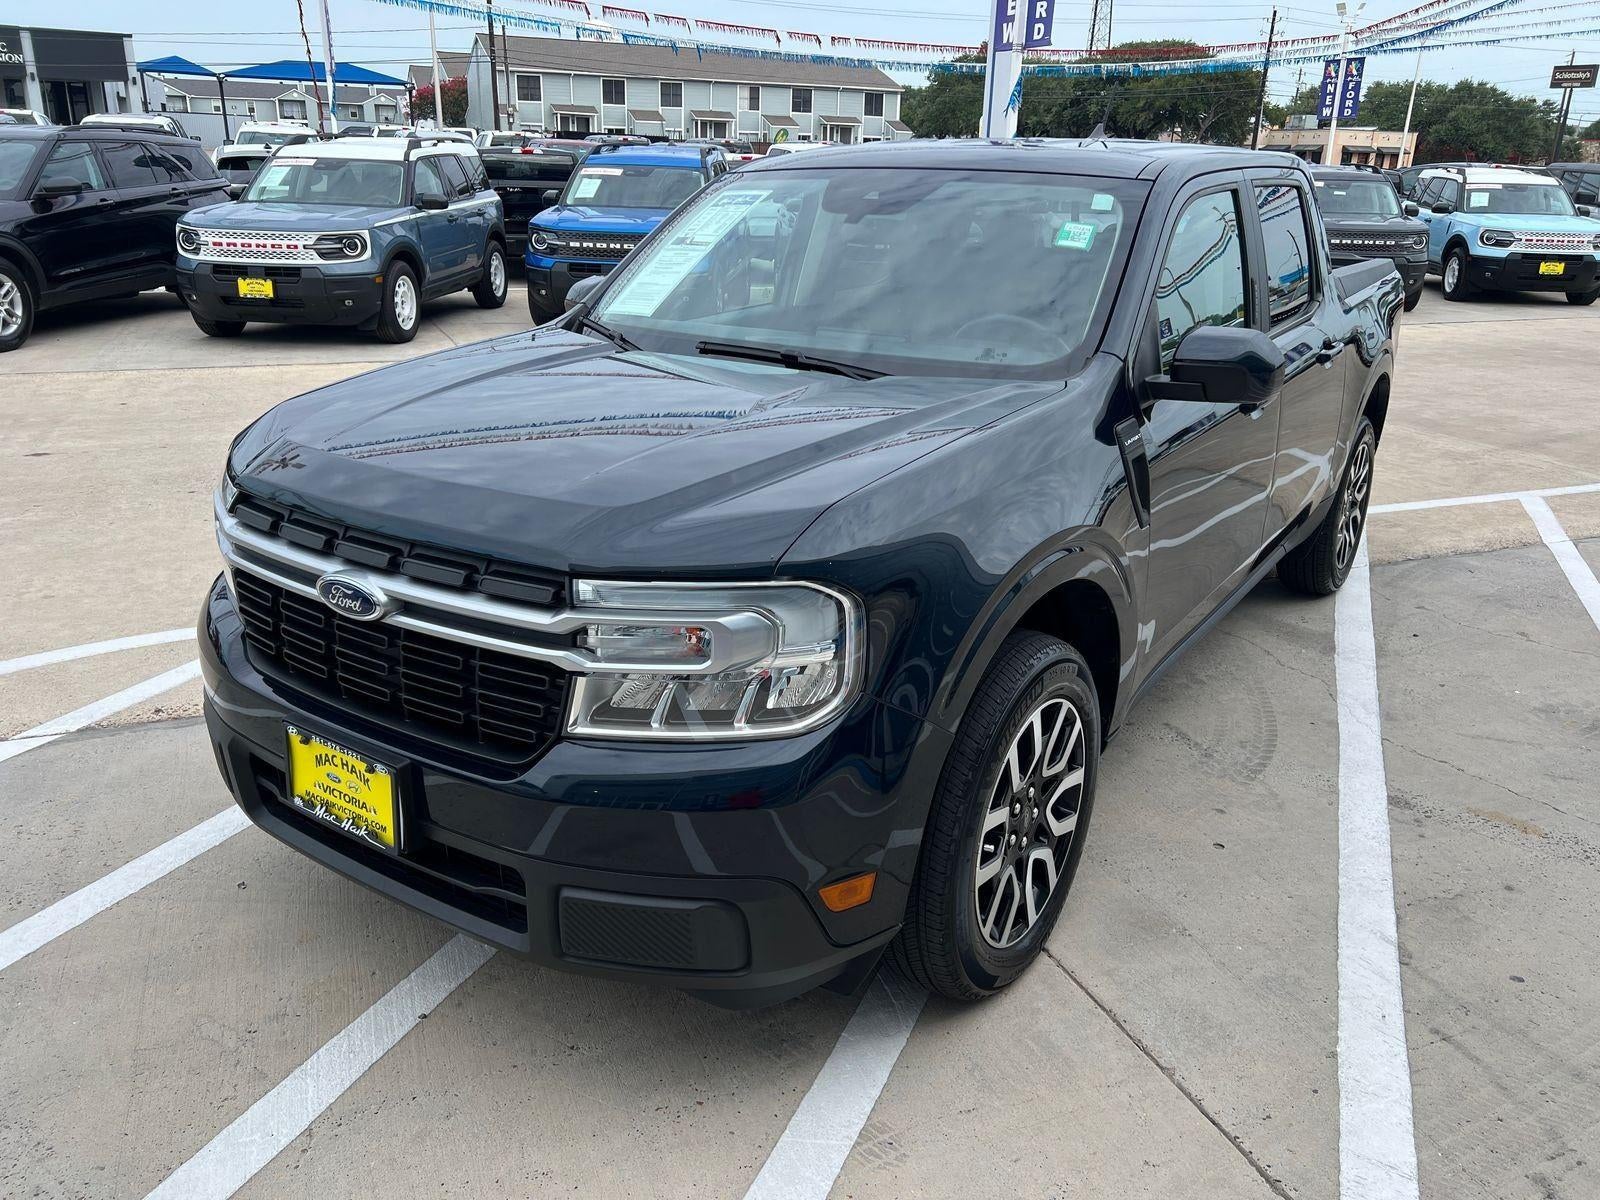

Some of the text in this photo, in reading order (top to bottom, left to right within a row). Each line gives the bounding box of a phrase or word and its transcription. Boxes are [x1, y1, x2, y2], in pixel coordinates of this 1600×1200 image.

[1003, 0, 1016, 43] EW
[1033, 0, 1048, 40] RD
[0, 42, 7, 52] C
[1322, 83, 1335, 117] NEW
[1343, 81, 1356, 117] FORD
[212, 241, 299, 250] BRONCO
[569, 241, 635, 249] BRONC
[328, 584, 363, 612] Ford
[315, 753, 372, 792] MAC HAIK
[305, 789, 387, 834] MACHAIKVICTORIA.COM
[321, 782, 369, 813] VICTORIA
[314, 804, 378, 843] Mac Haik
